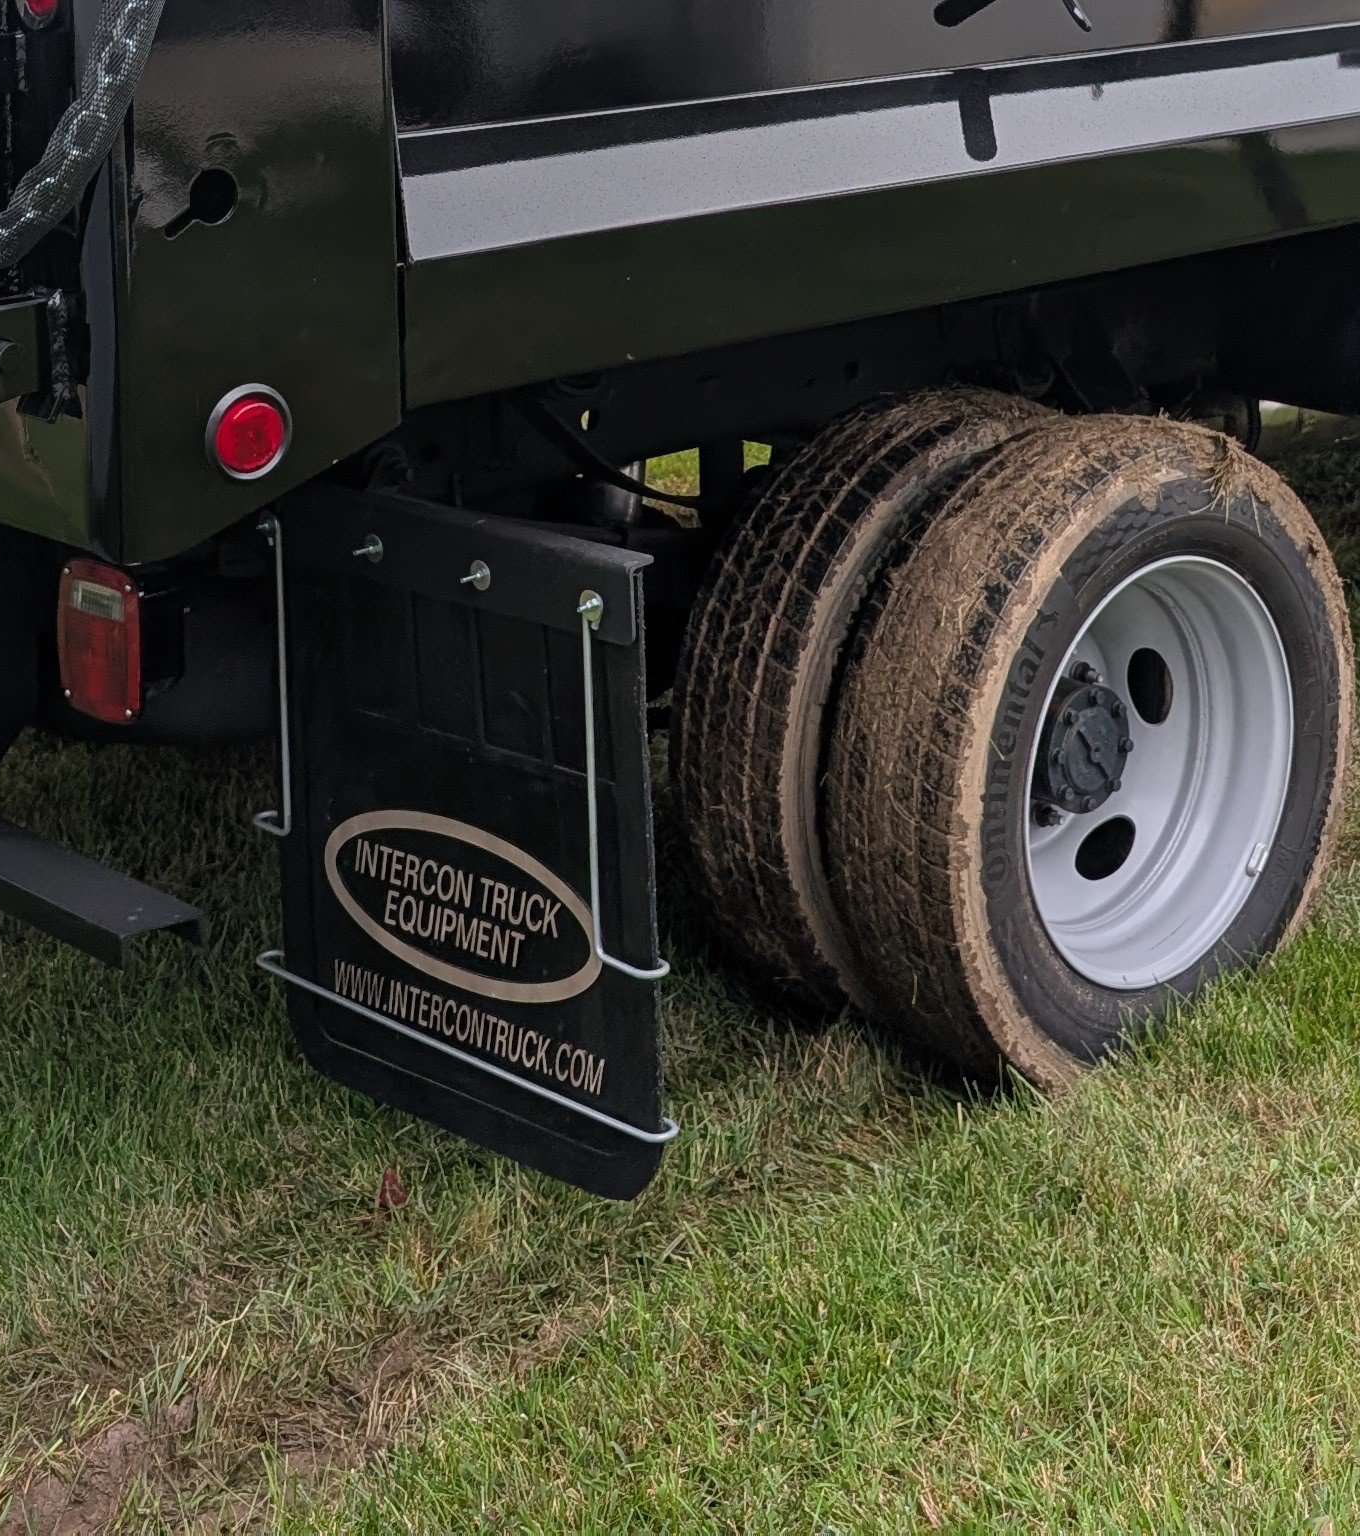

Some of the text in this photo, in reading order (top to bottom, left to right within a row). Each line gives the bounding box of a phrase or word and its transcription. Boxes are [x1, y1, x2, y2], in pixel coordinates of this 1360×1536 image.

[354, 838, 561, 939] INTERCON TRUCK
[384, 889, 526, 968] EQUIPMENT
[334, 958, 606, 1096] WWW.INTERCONTRUCK.COM
